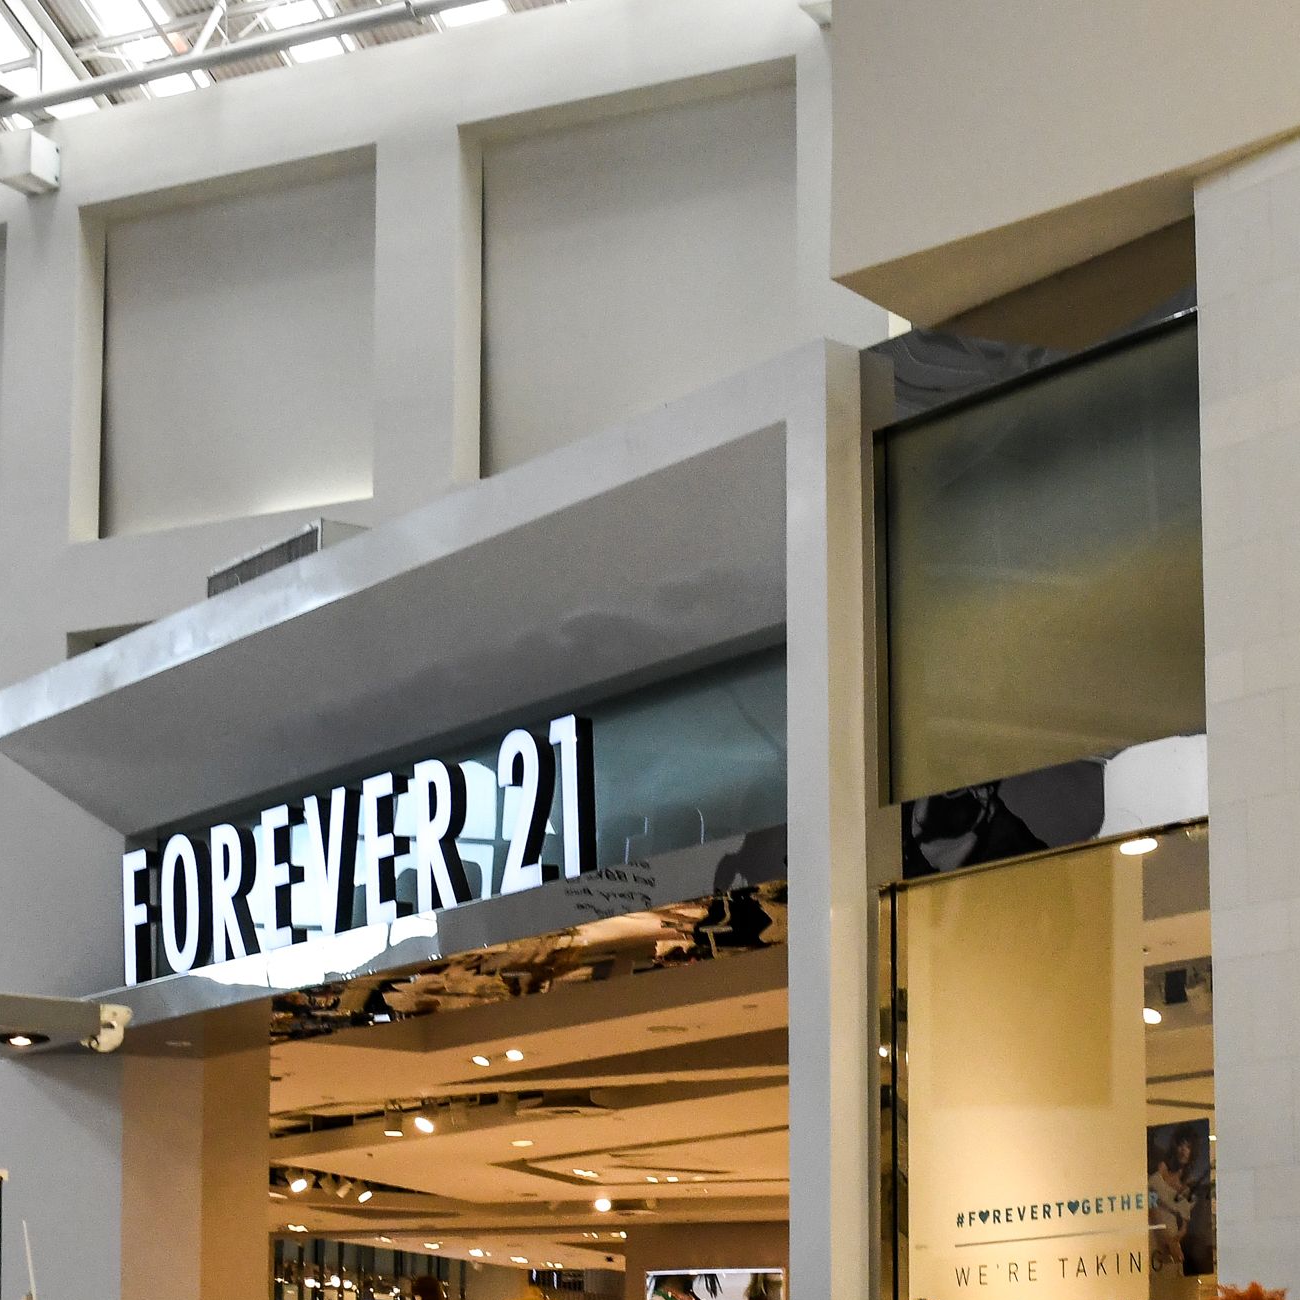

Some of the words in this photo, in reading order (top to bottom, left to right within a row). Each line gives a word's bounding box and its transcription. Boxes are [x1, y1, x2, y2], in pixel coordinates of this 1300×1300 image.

[122, 757, 466, 987] FOREVER
[497, 713, 591, 896] 21
[955, 1259, 1038, 1288] WE'RE
[1058, 1251, 1164, 1278] TAKING
